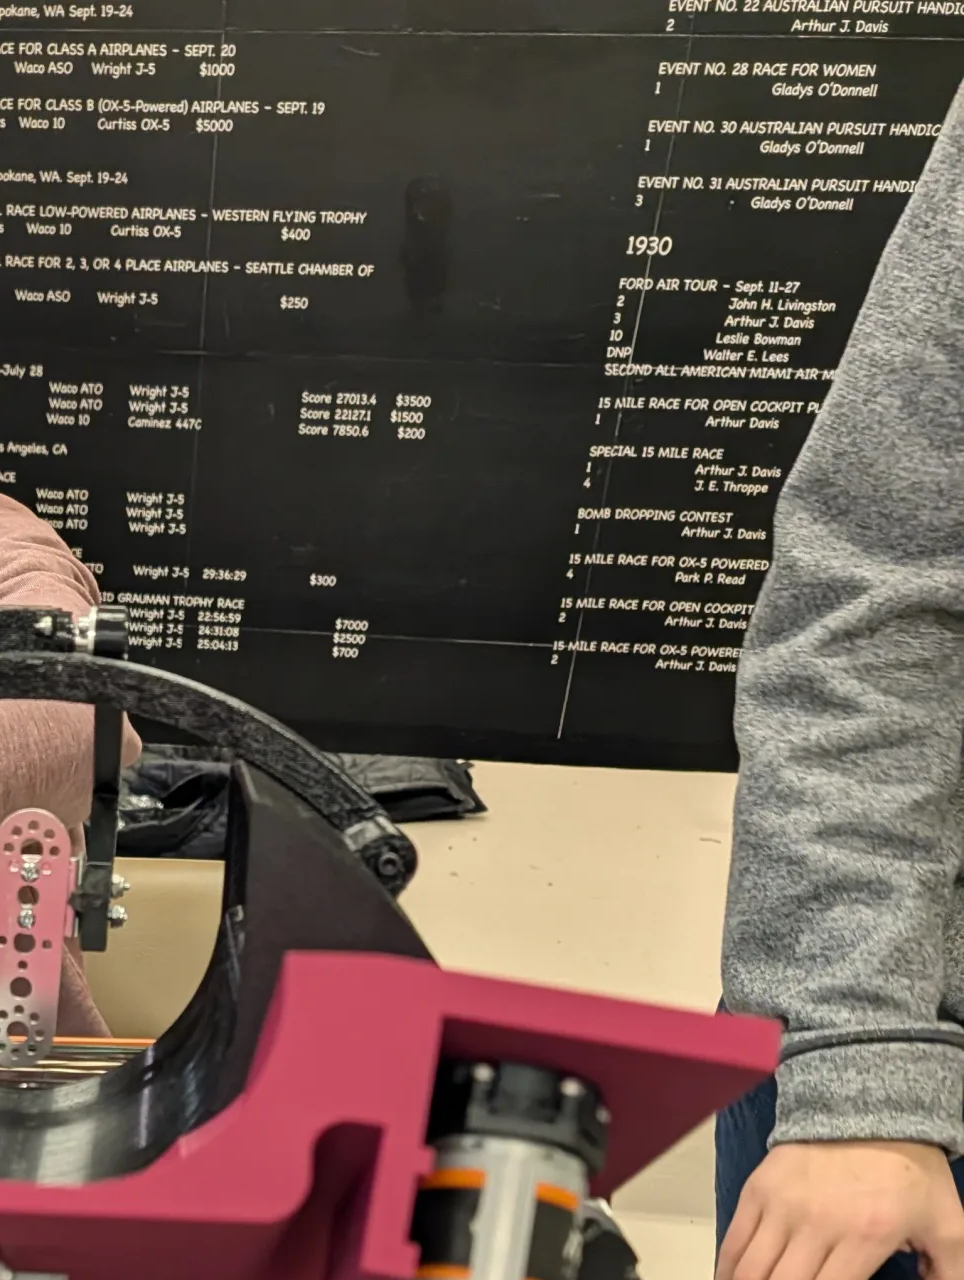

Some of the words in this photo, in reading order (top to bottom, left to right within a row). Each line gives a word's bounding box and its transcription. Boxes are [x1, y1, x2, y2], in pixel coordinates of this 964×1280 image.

[43, 5, 64, 17] WA
[69, 4, 96, 20] Sept.
[101, 4, 133, 17] 19-24
[666, 19, 676, 31] 2
[791, 19, 837, 31] Arthur
[839, 20, 852, 32] J.
[854, 21, 890, 33] Davis
[19, 42, 42, 55] FOR
[47, 43, 84, 55] CLASS
[87, 44, 96, 56] A
[100, 43, 167, 56] AIRPLANES
[185, 44, 215, 57] SEPT.
[221, 44, 236, 57] 20
[14, 62, 45, 74] Waco
[48, 61, 73, 74] ASO
[92, 63, 132, 79] Wright
[136, 63, 155, 75] J-5
[200, 62, 235, 77] $1000
[658, 62, 701, 74] EVENT
[704, 62, 729, 75] NO.
[732, 63, 750, 76] 28
[752, 63, 789, 76] RACE
[791, 63, 820, 76] FOR
[821, 64, 876, 76] WOMEN
[654, 82, 662, 94] 1
[770, 83, 815, 99] Gladys
[817, 83, 879, 97] O'Donnell
[18, 98, 41, 110] FOR
[45, 99, 82, 111] CLASS
[87, 99, 94, 111] B
[98, 99, 188, 115] (OX-5-Powered)
[191, 101, 259, 113] AIRPLANES
[277, 102, 307, 114] SEPT.
[312, 102, 325, 114] 19
[19, 117, 49, 129] Waco
[53, 117, 65, 129] 10
[98, 118, 136, 130] Curtiss
[141, 119, 170, 131] OX-5
[196, 119, 233, 133] $5000
[40, 171, 62, 182] WA.
[67, 172, 93, 186] Sept.
[98, 172, 128, 184] 19-24
[7, 205, 35, 216] RACE
[40, 206, 128, 218] LOW-POWERED
[131, 208, 196, 220] AIRPLANES
[212, 209, 269, 221] WESTERN
[273, 211, 316, 223] FLYING
[320, 212, 367, 224] TROPHY
[26, 223, 56, 234] Waco
[60, 224, 72, 235] 10
[111, 225, 149, 237] Curtiss
[153, 226, 181, 238] OX-5
[281, 227, 310, 241] $400
[626, 237, 674, 256] 1930
[618, 278, 654, 290] FORD
[656, 279, 680, 290] AIR
[682, 279, 718, 291] TOUR
[734, 281, 765, 295] Sept.
[768, 282, 800, 293] 11-27
[616, 295, 626, 306] 2
[728, 298, 758, 310] John
[760, 299, 774, 310] H.
[777, 299, 836, 315] Livingston
[609, 329, 624, 341] 10
[715, 333, 750, 344] Leslie
[753, 333, 802, 345] Bowman
[606, 346, 632, 358] DNP
[702, 350, 744, 361] Walter
[746, 350, 759, 361] E.
[762, 352, 790, 362] Lees
[49, 383, 78, 394] Waco
[80, 384, 103, 395] ATO
[130, 386, 167, 400] Wright
[302, 392, 332, 403] Score
[336, 394, 376, 405] 27013.4
[396, 394, 431, 407] $3500
[595, 414, 601, 424] 1
[705, 416, 746, 428] Arthur
[749, 416, 780, 429] Davis
[588, 445, 639, 457] SPECIAL
[641, 447, 656, 457] 15
[657, 447, 690, 458] MILE
[692, 448, 724, 459] RACE
[583, 478, 592, 488] 4
[694, 480, 706, 491] J.
[708, 480, 720, 491] E.
[720, 481, 770, 495] Throppe
[577, 508, 612, 520] BOMB
[614, 509, 676, 520] DROPPING
[679, 511, 734, 522] CONTEST
[568, 554, 582, 564] 15
[584, 554, 614, 565] MILE
[617, 554, 649, 565] RACE
[650, 556, 676, 567] FOR
[678, 557, 708, 568] OX-5
[710, 559, 770, 571] POWERED
[133, 567, 169, 579] Wright
[203, 569, 246, 580] 29:36:29
[310, 574, 336, 586] $300
[566, 569, 574, 578] 4
[674, 572, 702, 582] Park
[703, 573, 714, 584] P.
[716, 573, 746, 584] Read
